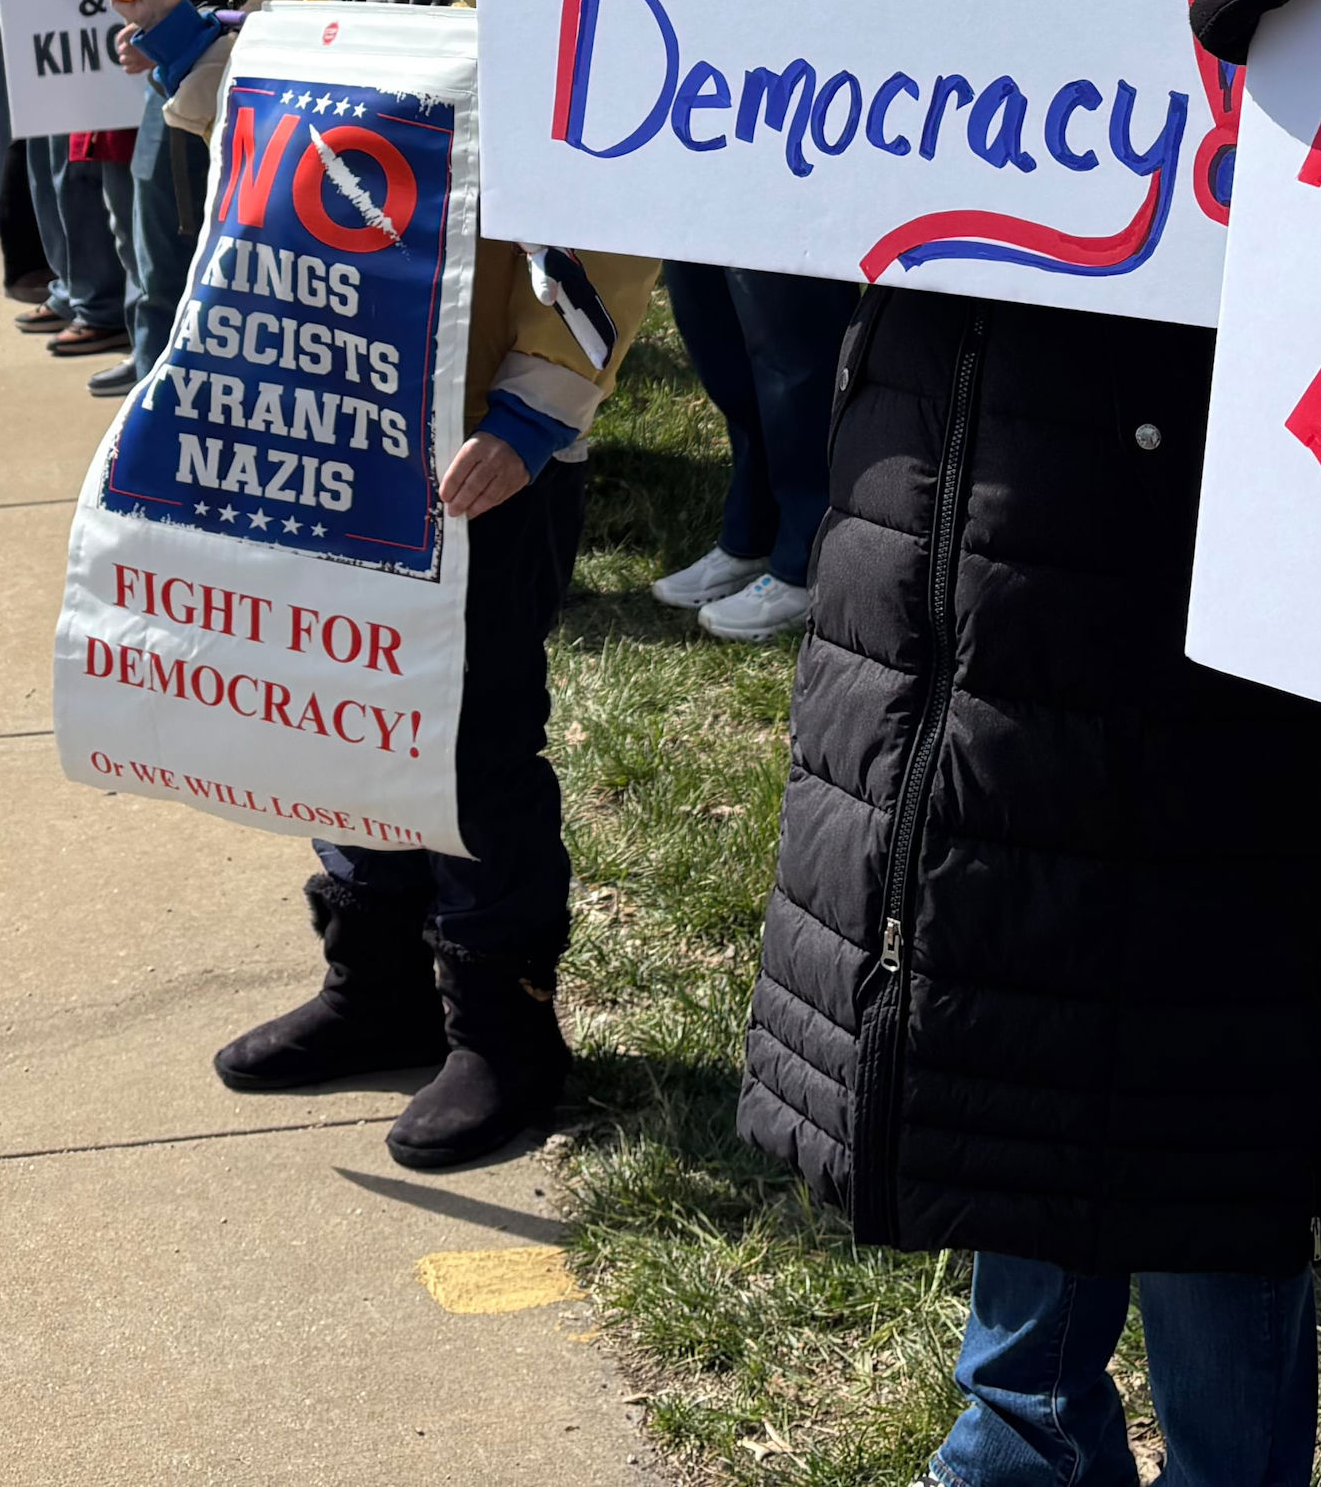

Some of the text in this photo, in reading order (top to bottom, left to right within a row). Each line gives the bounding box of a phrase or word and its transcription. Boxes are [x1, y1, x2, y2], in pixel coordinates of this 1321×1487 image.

[32, 23, 122, 78] KING
[217, 105, 419, 255] NO
[200, 235, 362, 318] KINGS
[174, 299, 401, 396] ASCISTS
[141, 363, 410, 459] TYRANTS
[175, 432, 355, 513] NAZIS
[112, 562, 404, 677] FIGHT FOR
[83, 634, 422, 760] DEMOCRACY!
[89, 751, 125, 778] Or
[129, 760, 180, 791] WE
[182, 774, 268, 814] WILL
[270, 796, 357, 832] LOSE
